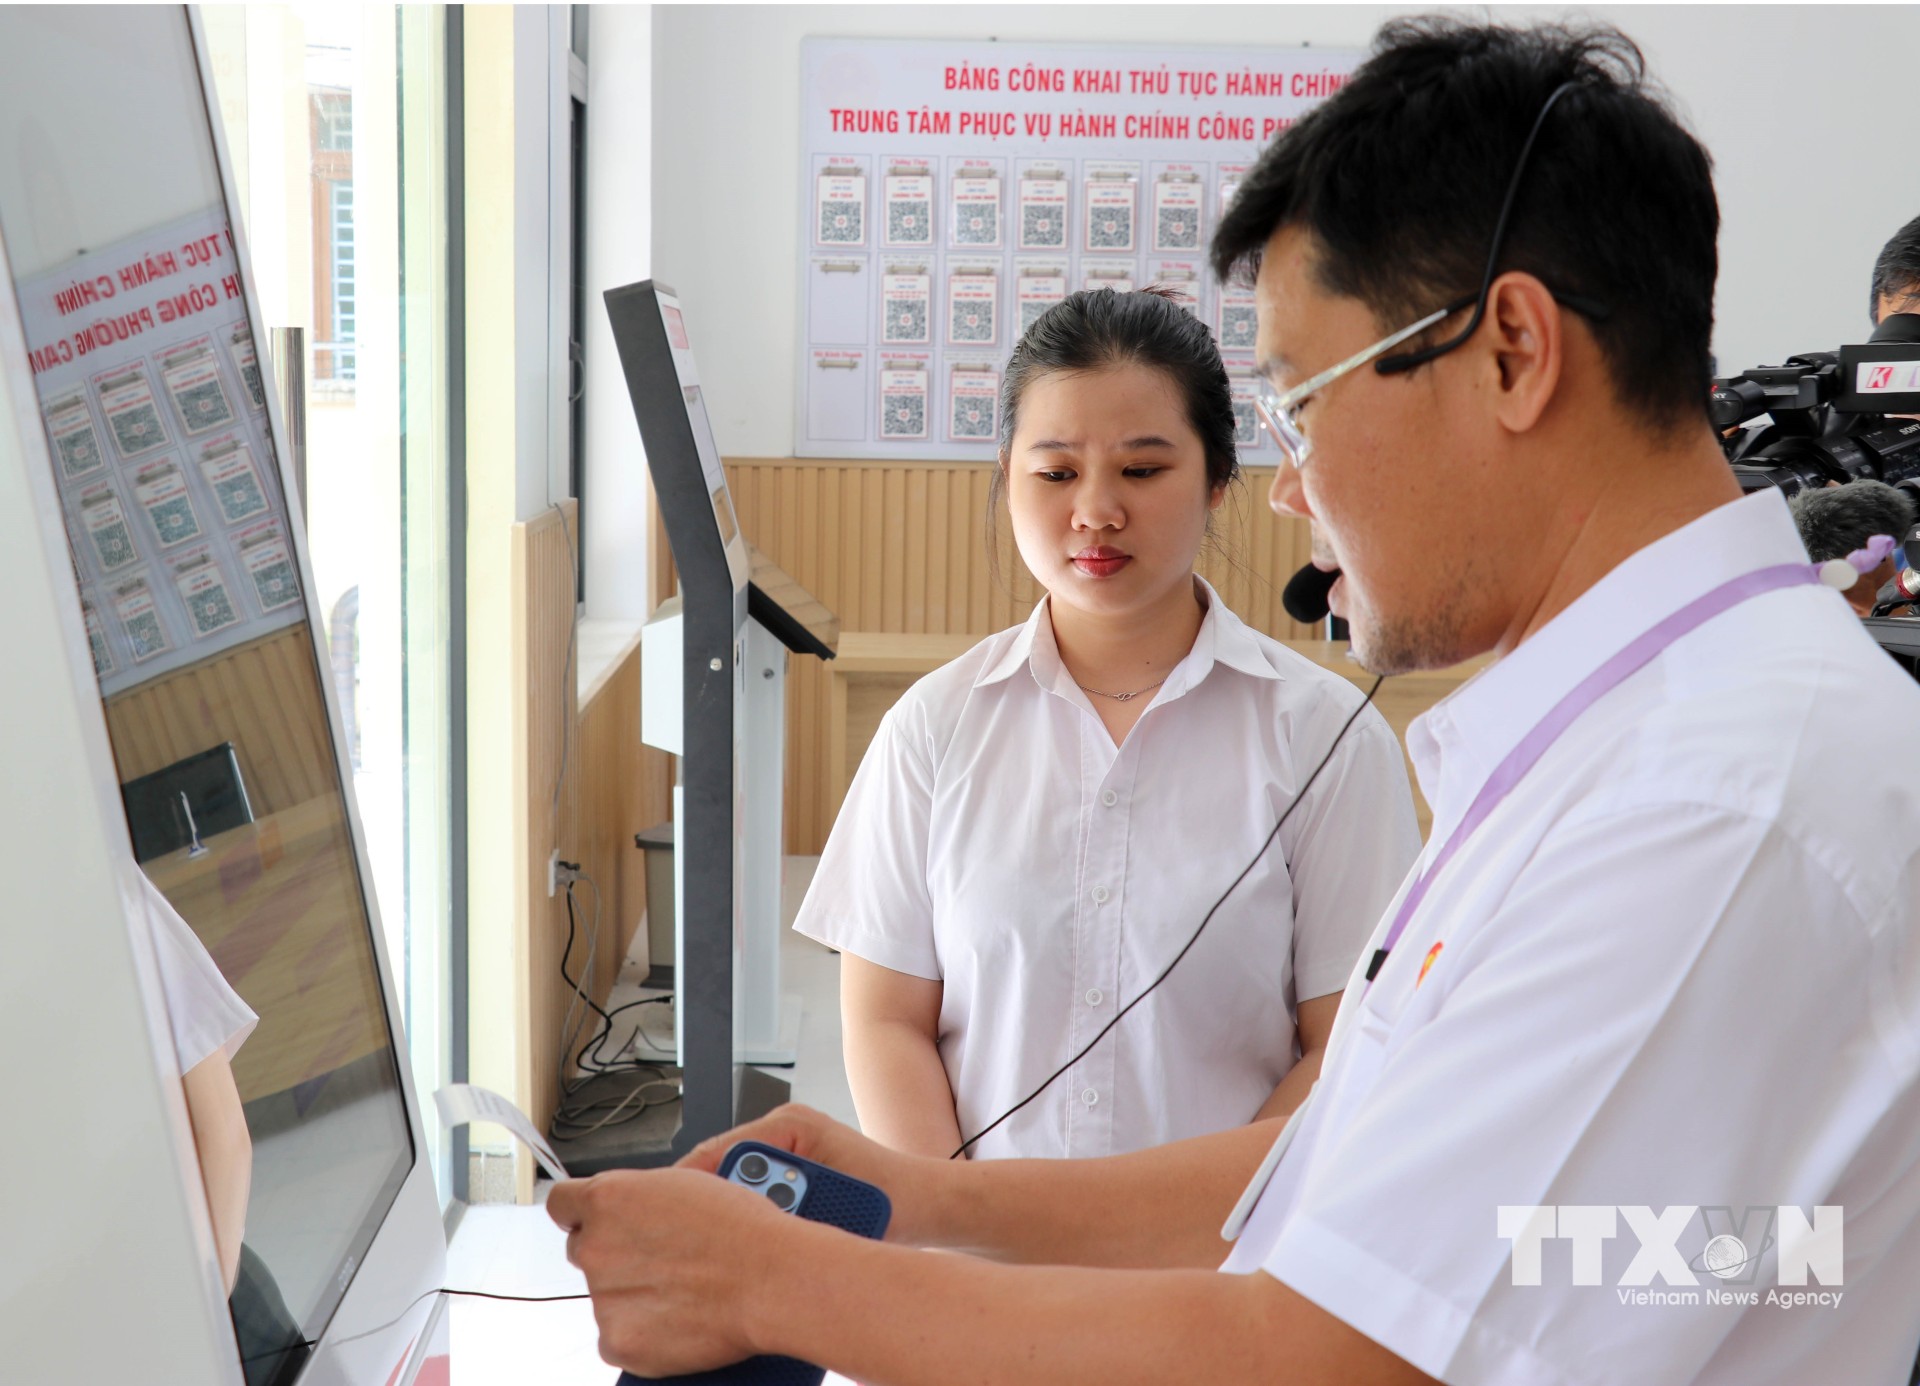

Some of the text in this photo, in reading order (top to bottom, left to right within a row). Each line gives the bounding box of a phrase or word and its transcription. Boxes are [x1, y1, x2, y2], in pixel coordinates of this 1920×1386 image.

[944, 60, 1000, 92] BẢNG
[1007, 62, 1066, 93] CÔNG
[1072, 69, 1122, 94] KHAI
[1128, 63, 1171, 96] THỦ
[1178, 70, 1218, 101] TỤC
[1225, 66, 1284, 97] HÀNH
[829, 108, 900, 134] TRUNG
[907, 105, 952, 135] TÂM
[959, 111, 1017, 142] PHỤC
[1024, 112, 1052, 142] VỤ
[1059, 109, 1117, 138] HÀNH
[1124, 110, 1191, 140] CHÍNH
[1197, 110, 1255, 141] CÔNG
